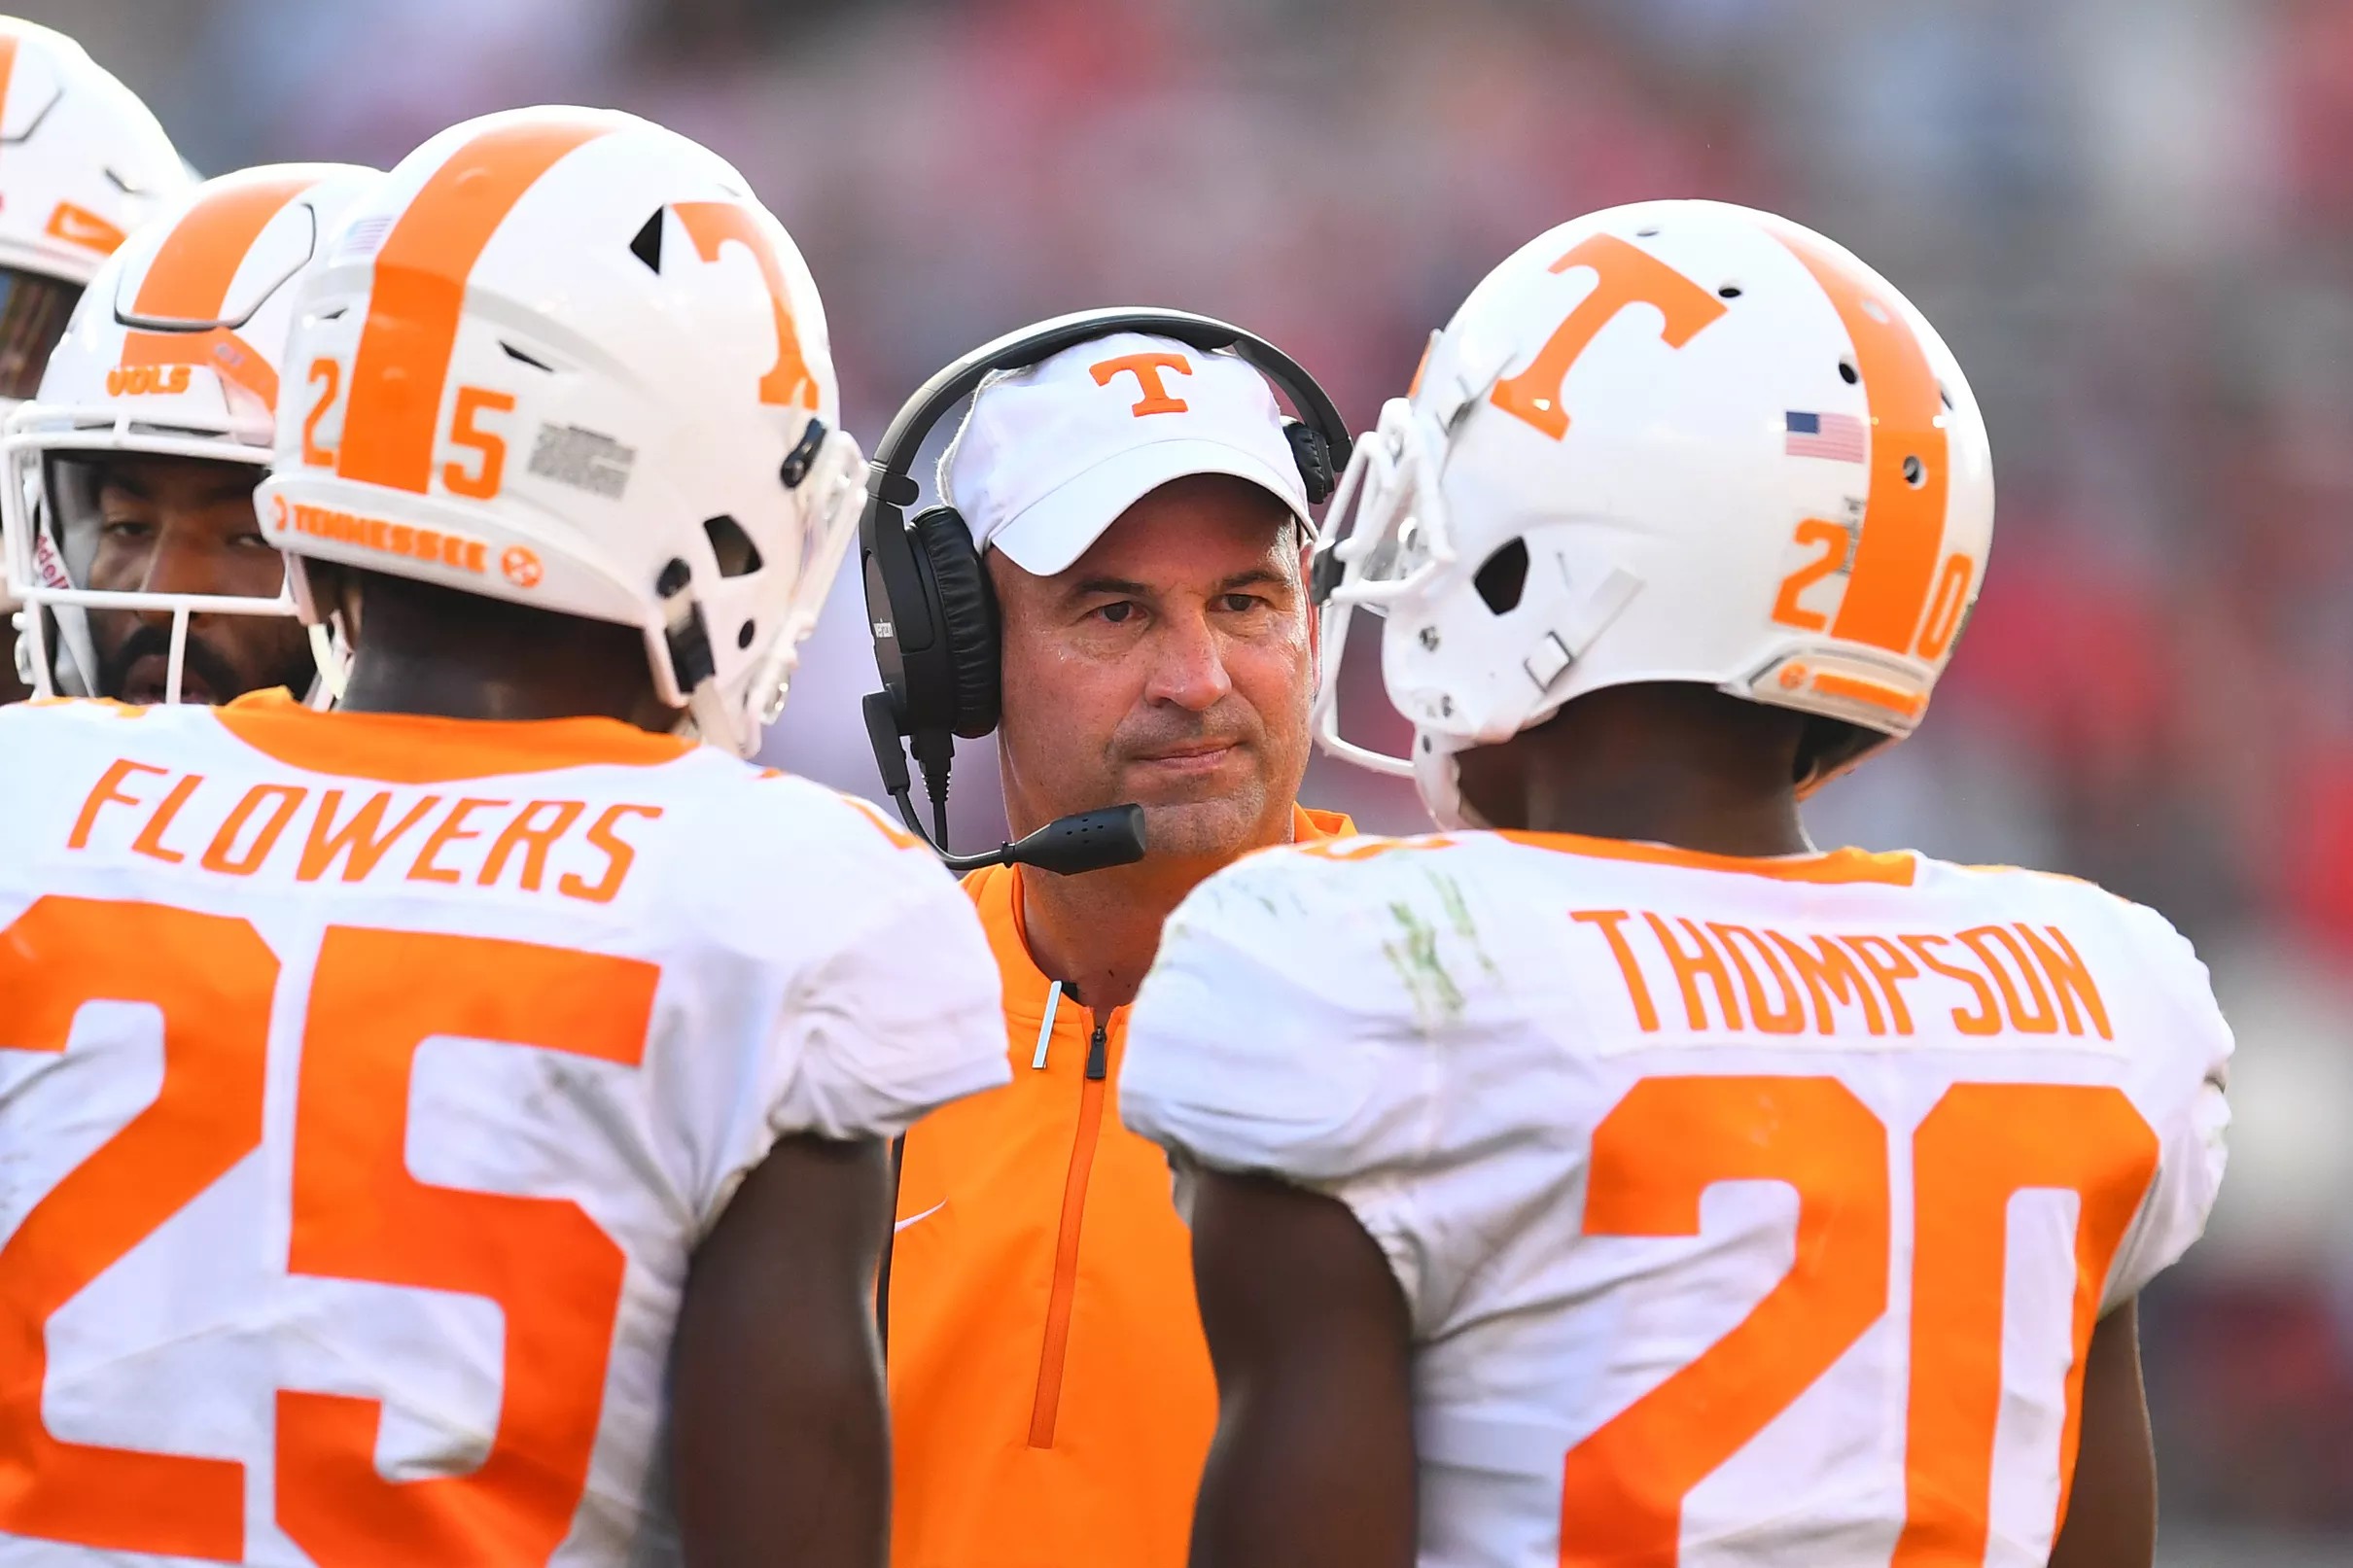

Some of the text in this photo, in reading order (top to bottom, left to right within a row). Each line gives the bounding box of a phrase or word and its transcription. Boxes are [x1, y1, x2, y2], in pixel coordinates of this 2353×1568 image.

[672, 202, 819, 411] T
[1491, 233, 1728, 440] T
[106, 364, 191, 398] VOLS
[1089, 353, 1193, 417] T
[293, 504, 488, 574] TENNESSEE
[70, 759, 663, 902] FLOWERS
[1570, 910, 2113, 1040] THOMPSON
[0, 894, 661, 1568] 25
[1560, 1075, 2160, 1568] 20
